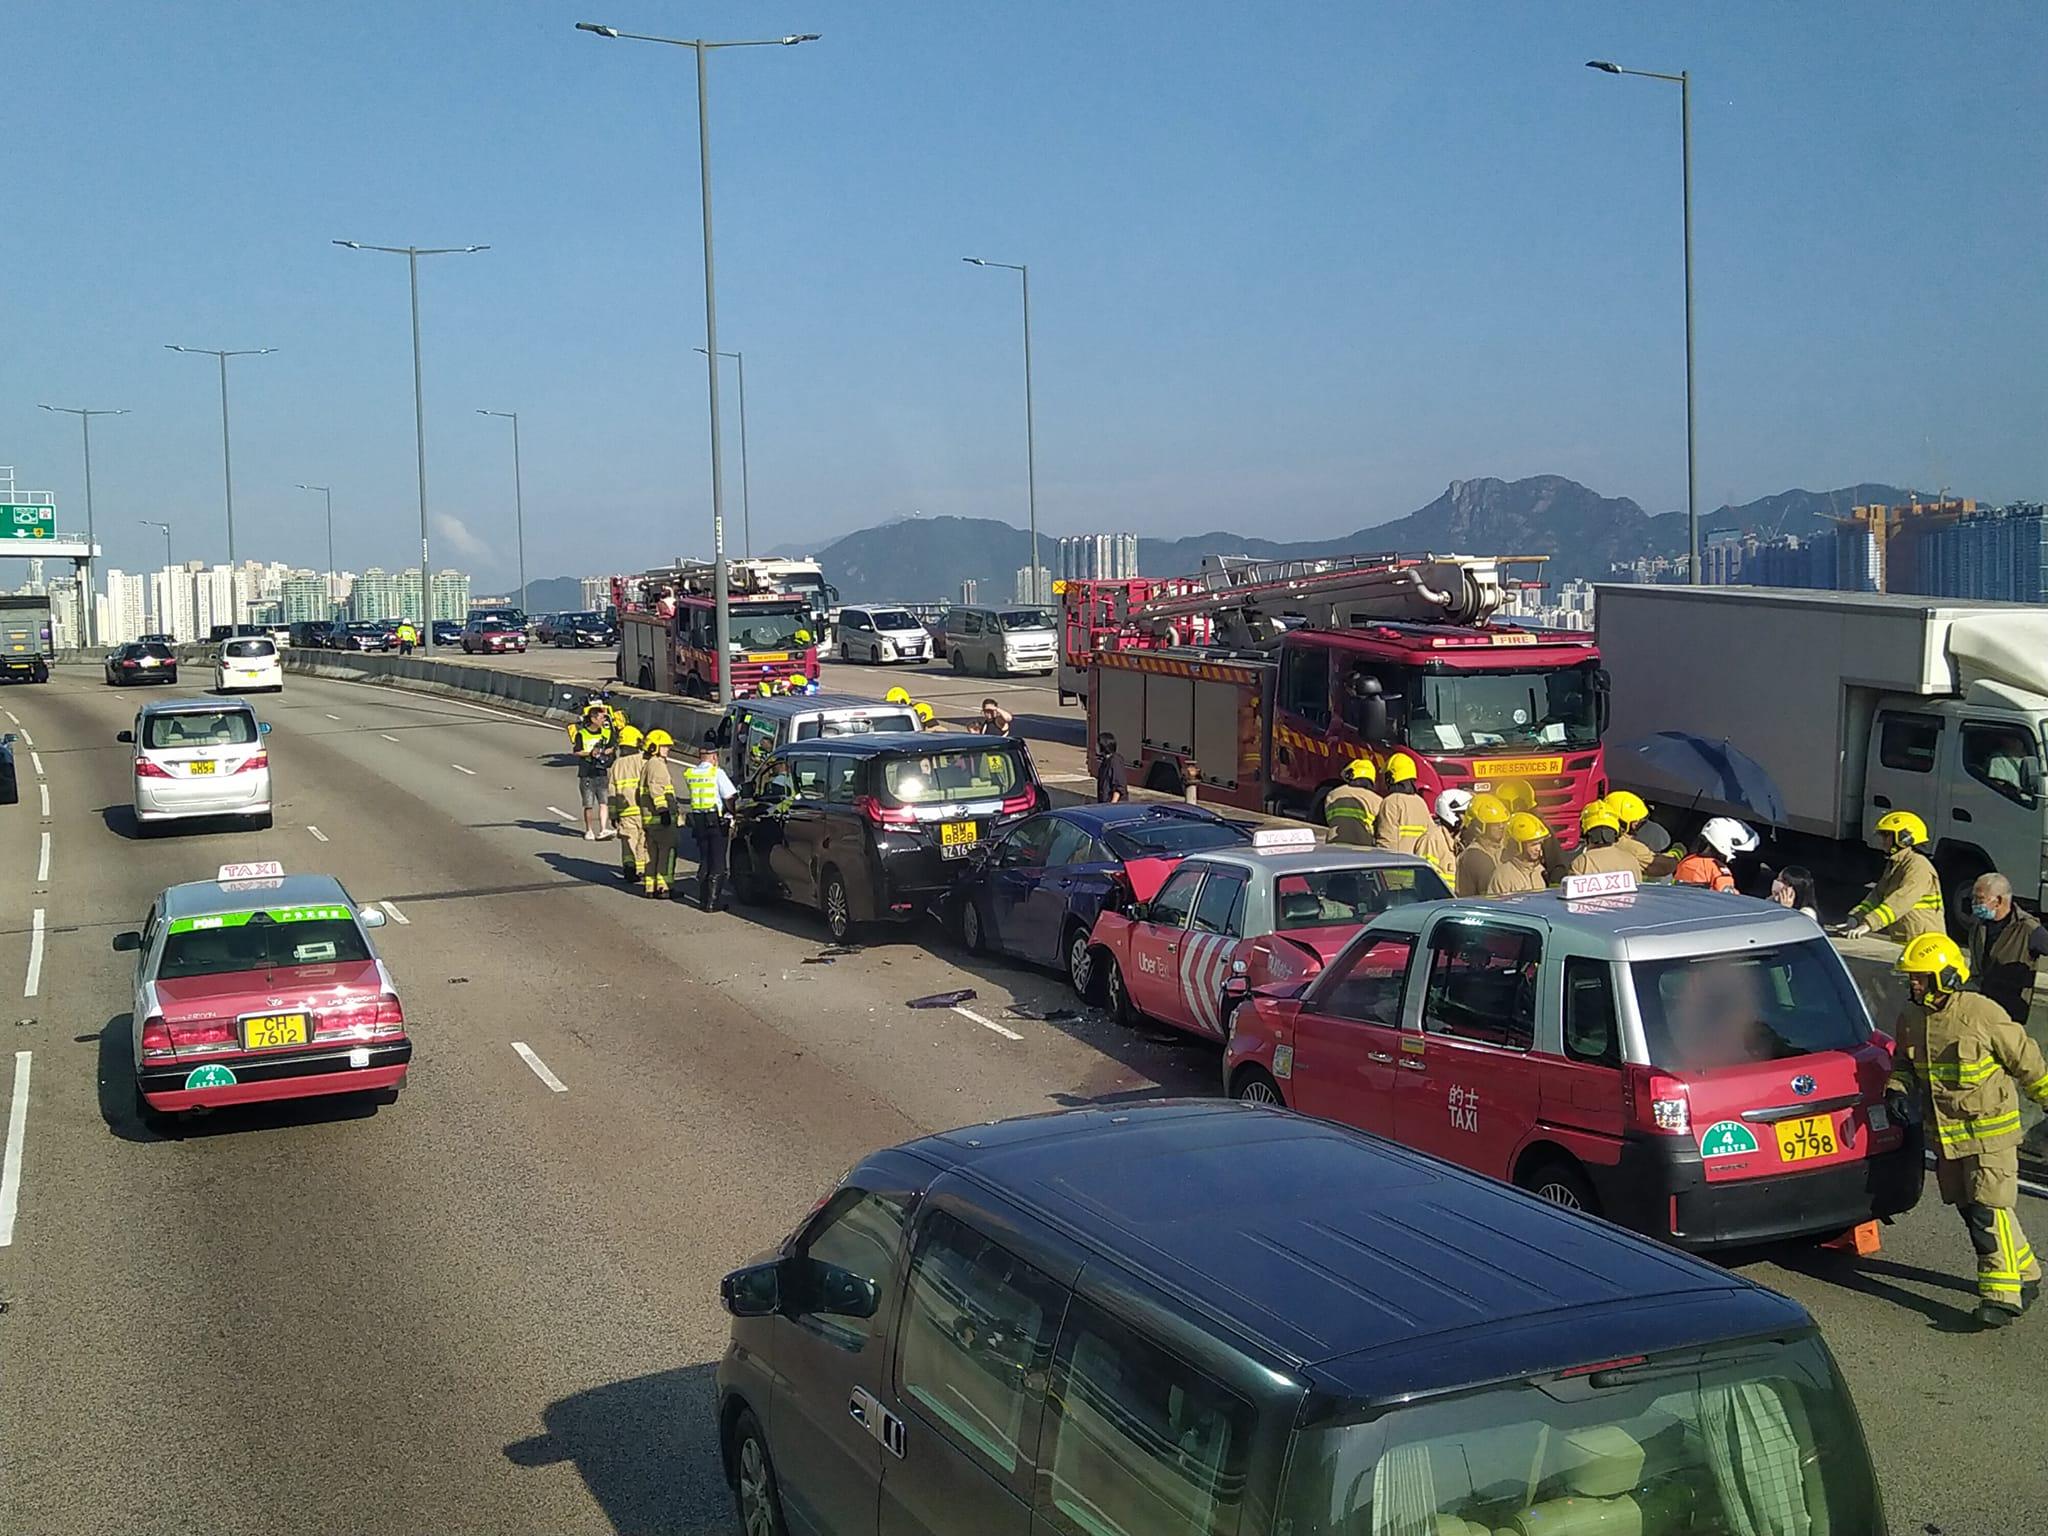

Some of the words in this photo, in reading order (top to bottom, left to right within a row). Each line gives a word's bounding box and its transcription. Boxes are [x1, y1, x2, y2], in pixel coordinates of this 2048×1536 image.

[1500, 635, 1529, 644] FIRE
[1489, 764, 1508, 774] FIRE
[1509, 761, 1547, 773] SERVICES
[951, 823, 967, 834] BM
[224, 863, 277, 878] TAXI
[1573, 873, 1631, 893] TAXI
[1138, 951, 1157, 974] Uber
[264, 1015, 288, 1031] CH
[255, 1029, 299, 1045] 7612
[205, 1071, 216, 1081] 4
[1449, 1084, 1480, 1107] 的士
[1448, 1104, 1478, 1133] TAXI
[1794, 1118, 1819, 1140] JZ
[1721, 1131, 1734, 1145] 4
[1783, 1135, 1834, 1160] 9798
